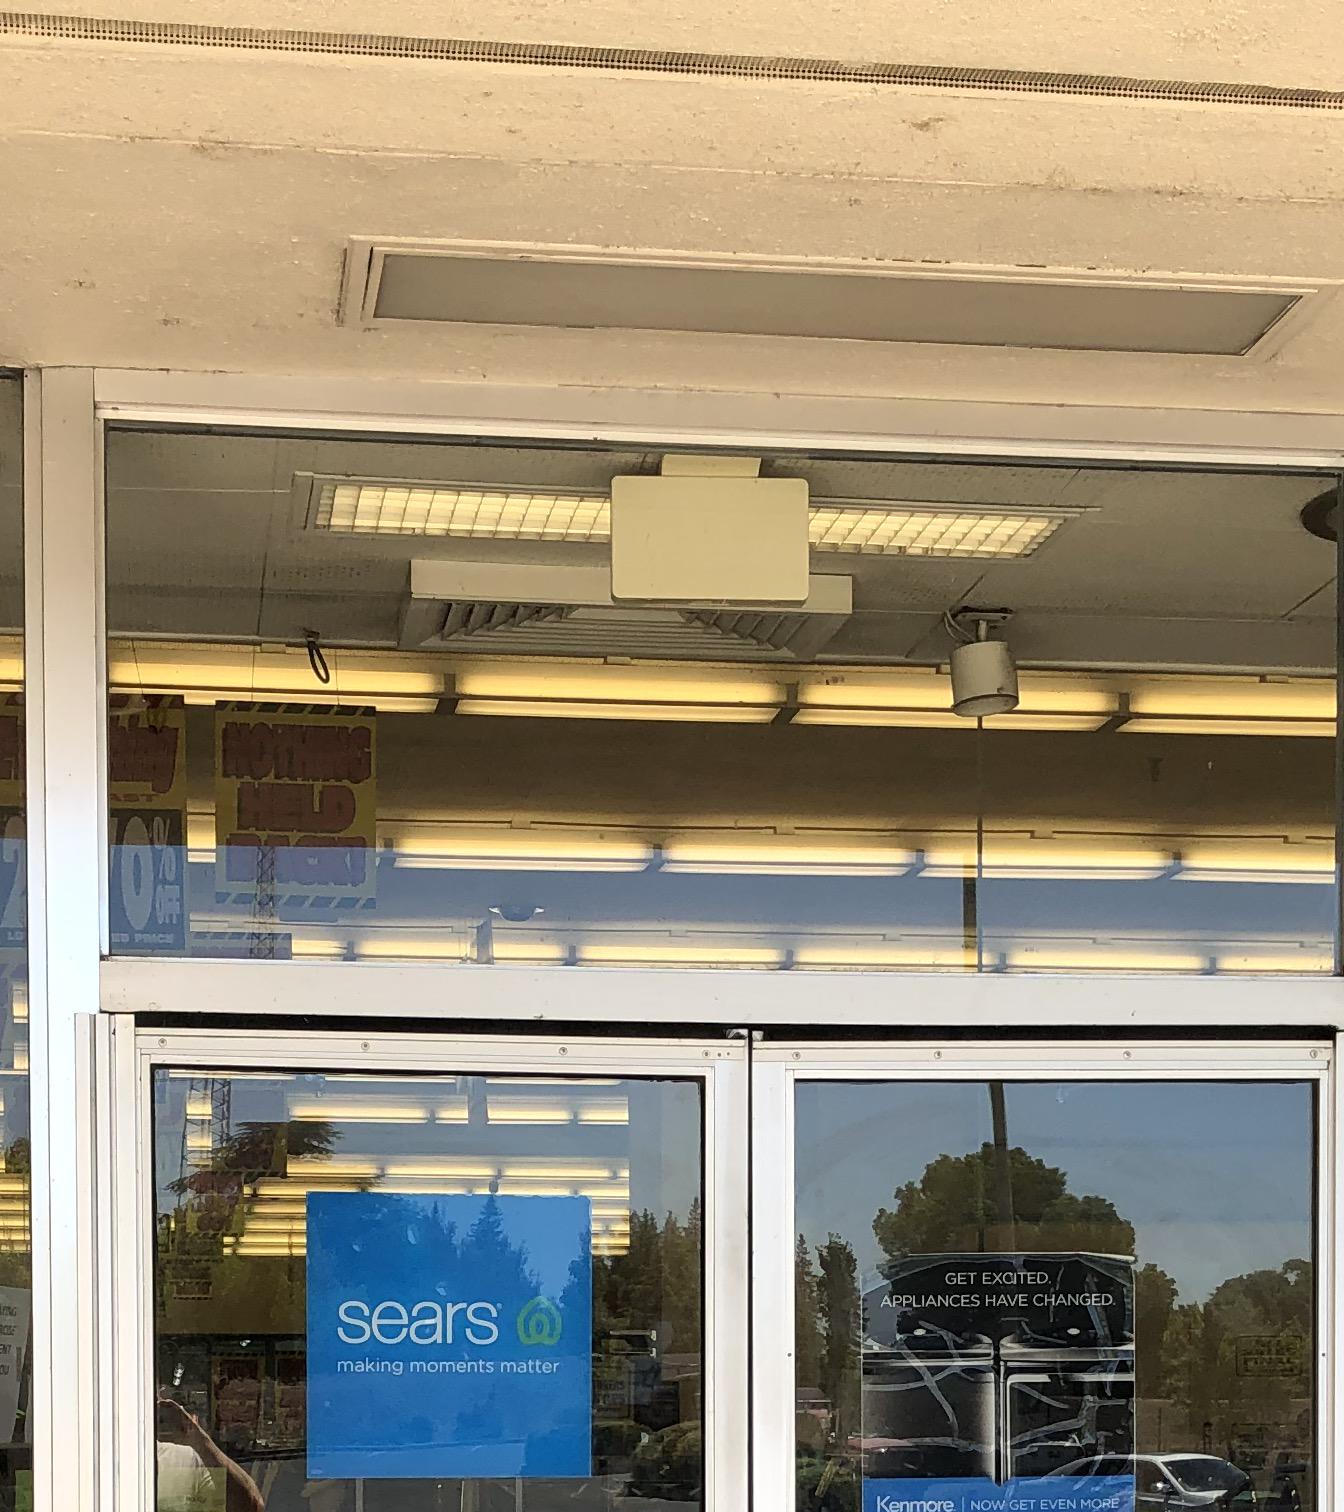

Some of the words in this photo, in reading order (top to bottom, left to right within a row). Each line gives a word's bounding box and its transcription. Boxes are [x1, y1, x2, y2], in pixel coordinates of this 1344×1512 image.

[945, 1272, 977, 1285] GET
[982, 1271, 1052, 1285] EXCITED.
[880, 1294, 981, 1308] APPLIANCES
[985, 1294, 1028, 1307] HAVE
[1033, 1293, 1116, 1307] CHANGED.
[337, 1300, 499, 1345] sears
[337, 1357, 403, 1376] making
[410, 1359, 494, 1373] moments
[500, 1359, 560, 1374] matter
[876, 1495, 955, 1512] Kenmore
[970, 1500, 1005, 1511] NOW
[1009, 1499, 1036, 1511] GET
[1040, 1499, 1077, 1510] EVEN
[1081, 1498, 1120, 1509] MORE
